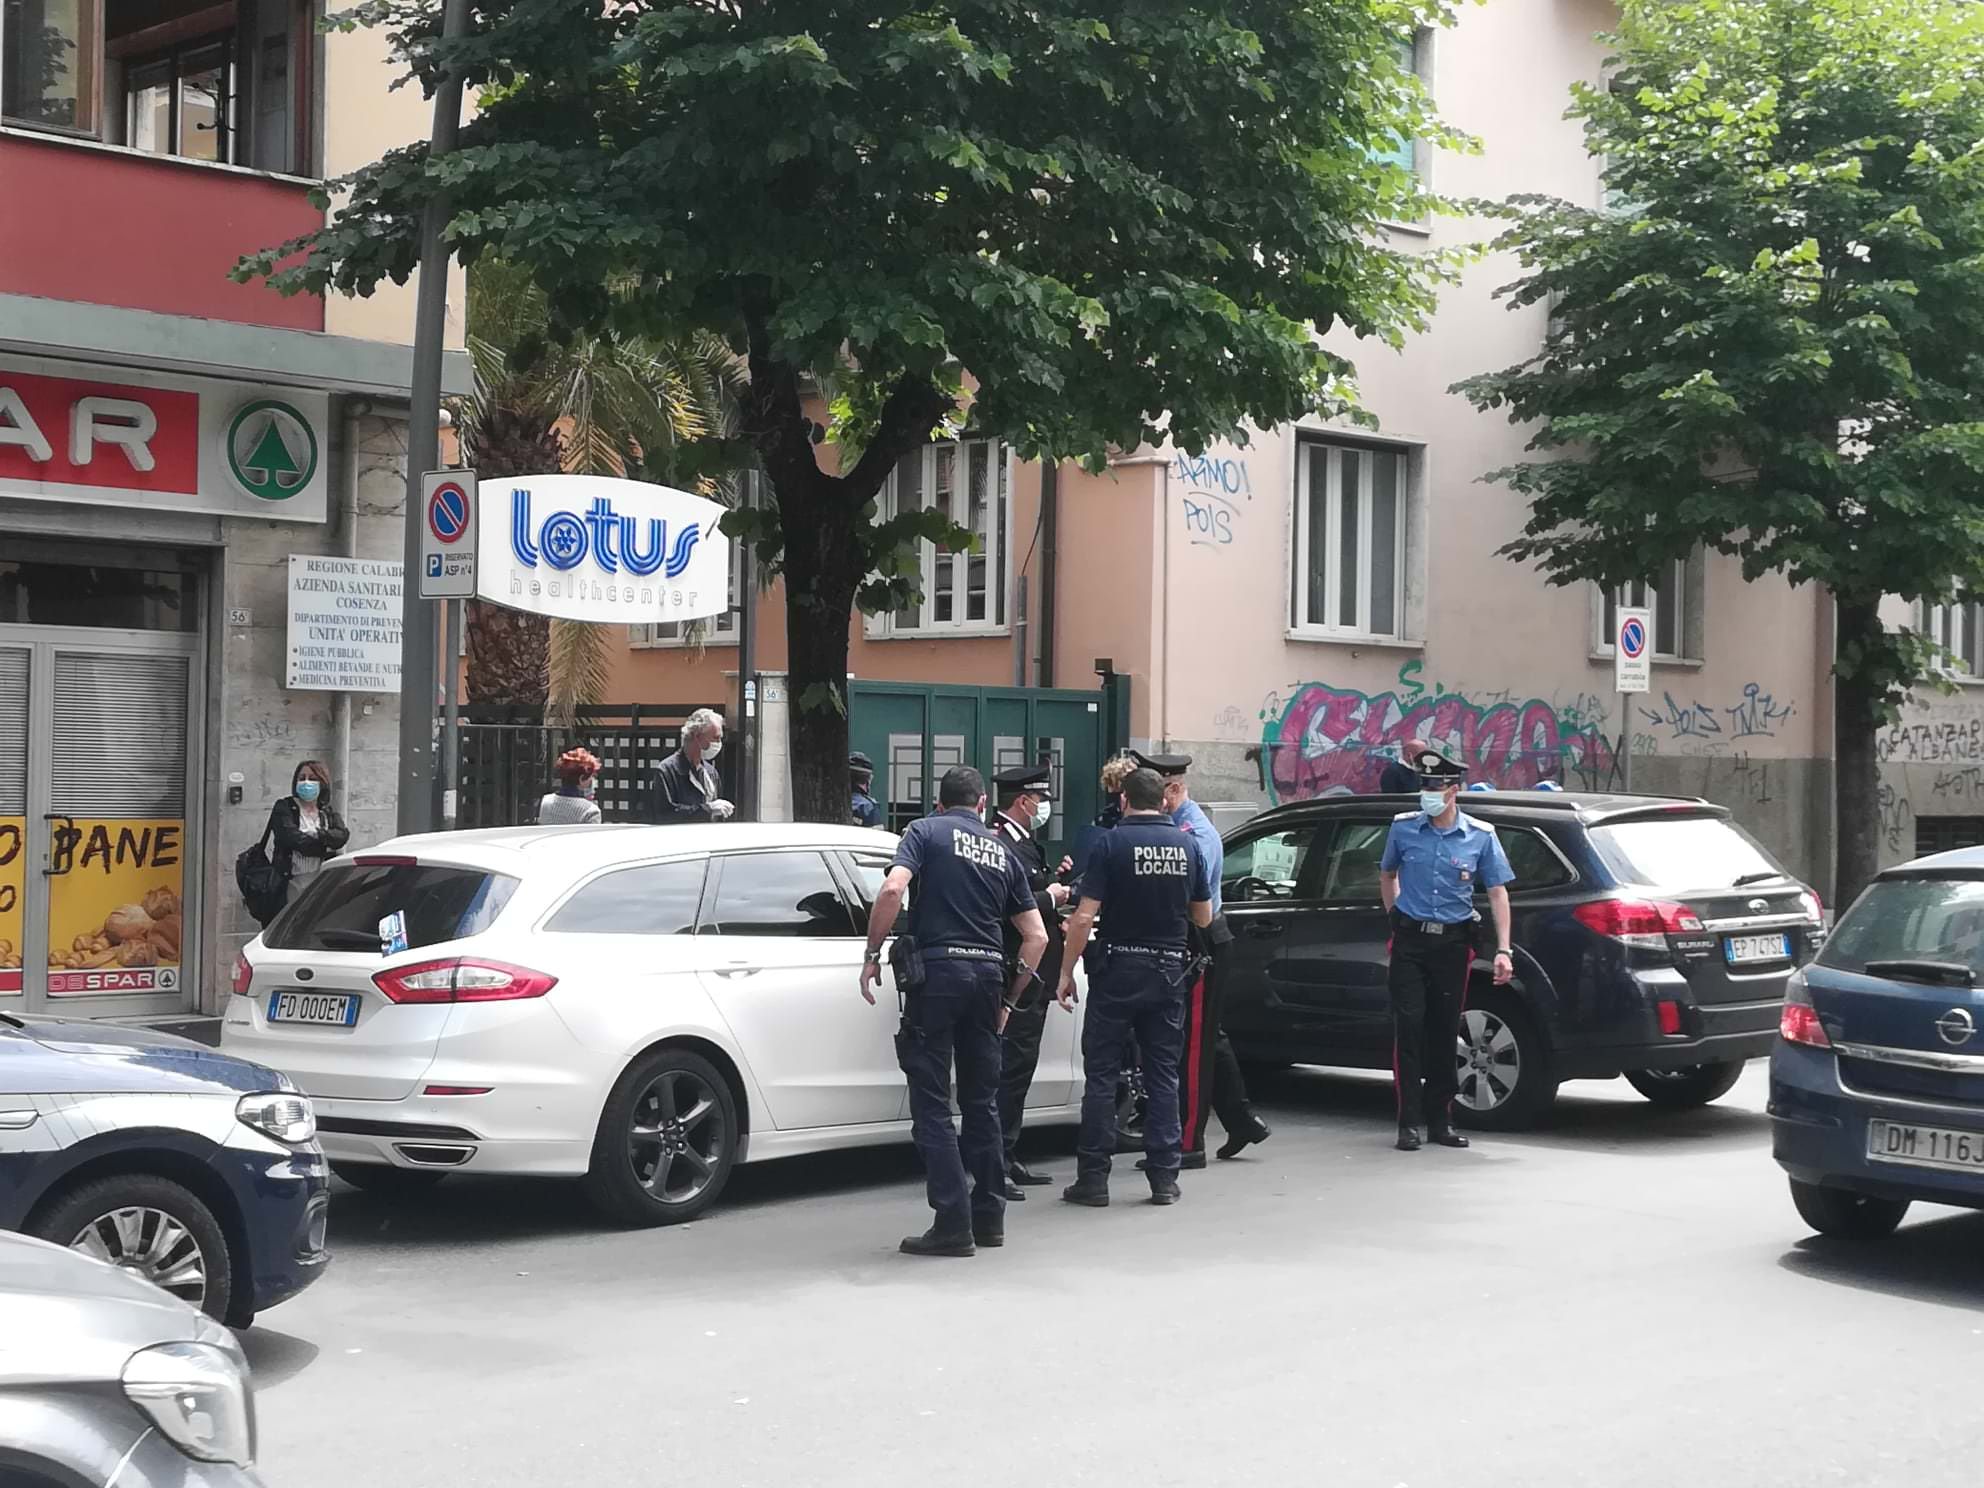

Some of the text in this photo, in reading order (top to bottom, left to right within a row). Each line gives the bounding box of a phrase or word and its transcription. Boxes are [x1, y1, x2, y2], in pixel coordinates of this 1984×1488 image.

[307, 560, 359, 575] REGIONE
[294, 578, 345, 594] AZIENDA
[509, 570, 698, 608] healthcenter
[336, 597, 387, 611] COSENZA
[295, 613, 359, 626] DIPARTIMENTO
[360, 615, 370, 626] DI
[299, 646, 365, 659] IGIENE PUBBLICA
[299, 660, 337, 673] ALIMENTI
[299, 674, 337, 686] MEDICINA
[953, 828, 1006, 857] POLIZIA
[954, 843, 1007, 873] LOCALE
[1134, 846, 1188, 861] POLIZIA
[1134, 861, 1188, 876] LOCALE
[1887, 1126, 1917, 1155] DM
